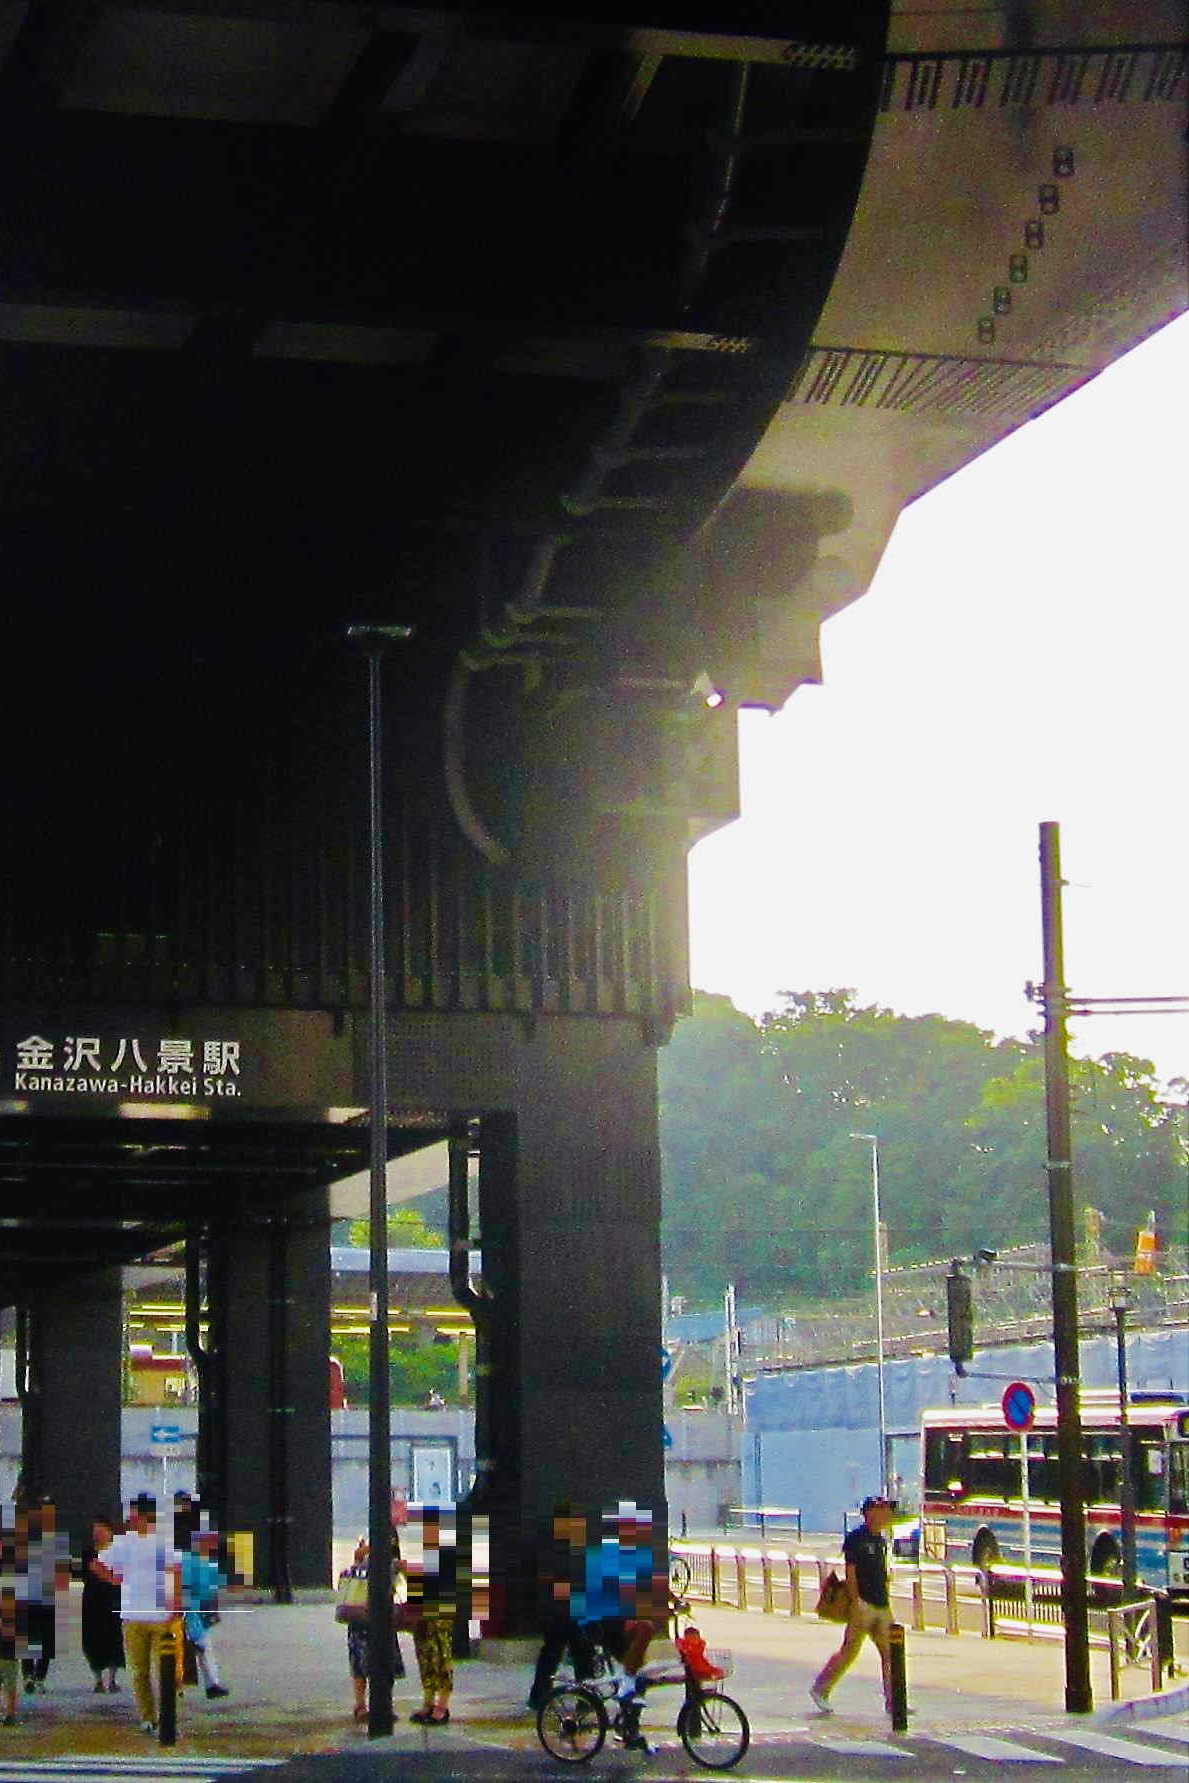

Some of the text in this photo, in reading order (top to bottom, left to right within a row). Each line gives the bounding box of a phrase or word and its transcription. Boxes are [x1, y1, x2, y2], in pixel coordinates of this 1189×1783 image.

[16, 1035, 241, 1075] 金沢八景駅
[15, 1072, 242, 1097] Kanazawa-Hakkei Sta.
